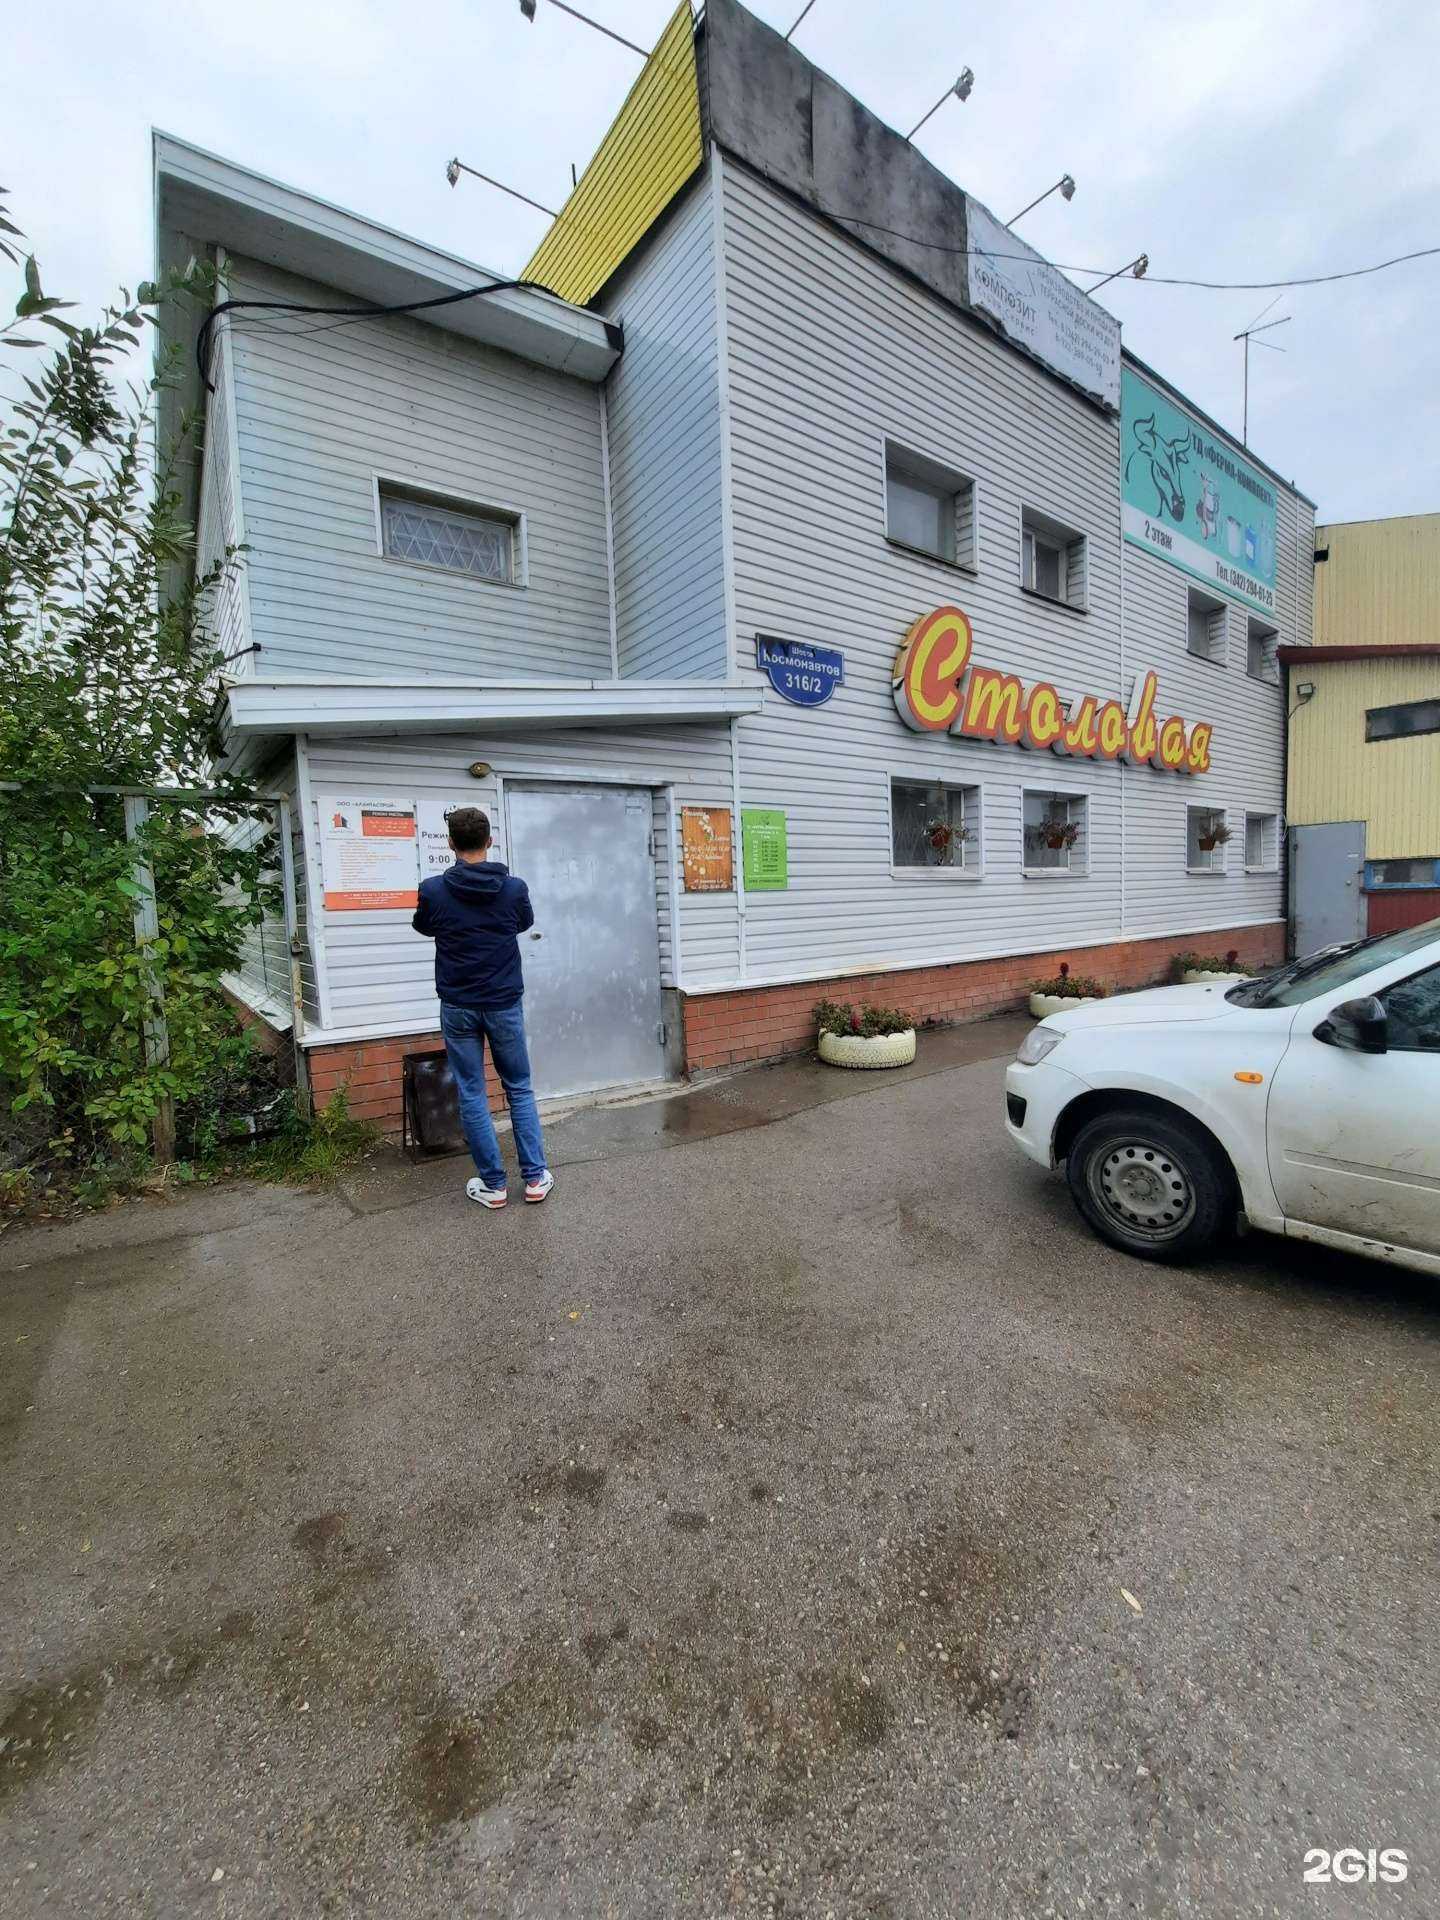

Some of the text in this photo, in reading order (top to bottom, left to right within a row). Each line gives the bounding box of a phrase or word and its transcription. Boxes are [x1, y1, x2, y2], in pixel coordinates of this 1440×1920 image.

[974, 264, 1037, 322] КОМПОЗИТ
[1144, 519, 1173, 551] 2 этаж
[1230, 569, 1246, 592] (342)
[763, 648, 840, 677] Космонавтов
[785, 672, 822, 694] 316/2
[901, 606, 1212, 773] Столовая
[428, 854, 450, 864] 9:00
